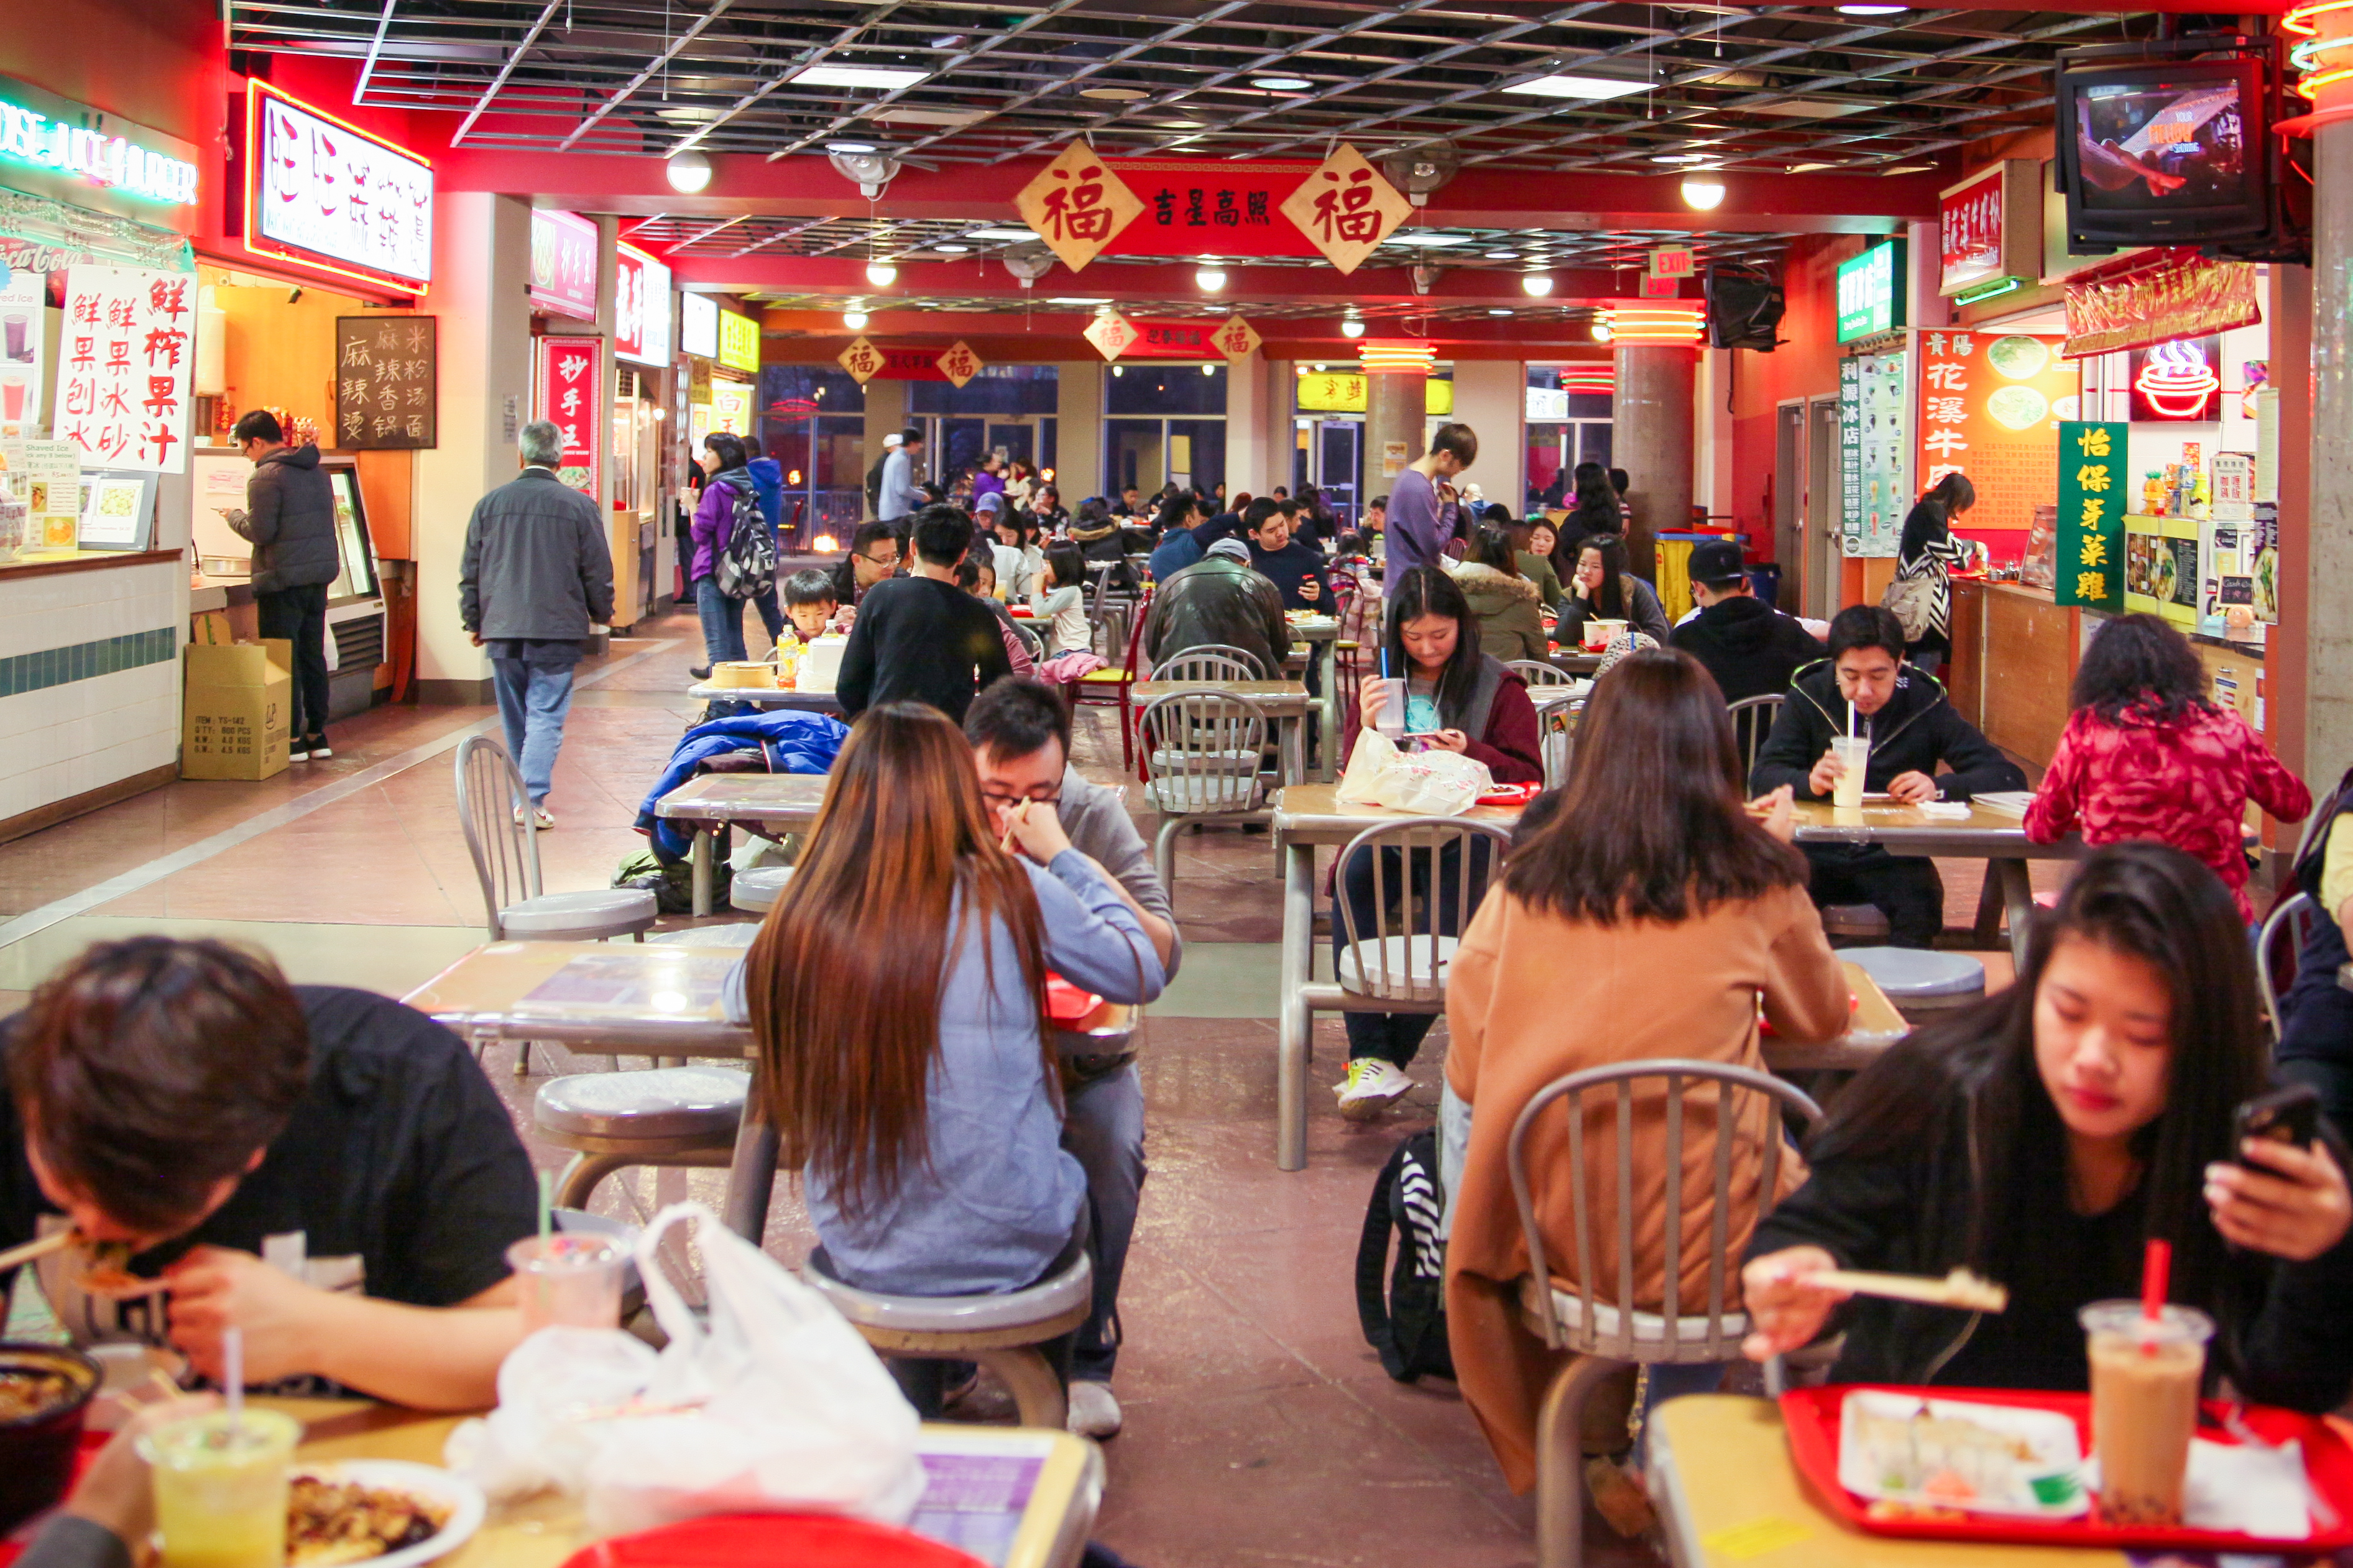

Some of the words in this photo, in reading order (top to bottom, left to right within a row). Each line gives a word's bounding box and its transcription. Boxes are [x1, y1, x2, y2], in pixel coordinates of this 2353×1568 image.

[2176, 111, 2193, 122] YOUR
[48, 121, 108, 179] JUICE
[1041, 165, 1113, 242] 福
[1153, 188, 1270, 227] 吉星高照
[1312, 167, 1382, 244] 福
[1658, 252, 1688, 273] EXIT
[17, 294, 34, 303] Ice
[1100, 319, 1125, 347] 福
[1223, 326, 1249, 353] 福
[1926, 332, 1974, 357] 貴陽
[63, 293, 101, 453] 鮮果刨冰
[97, 297, 137, 462] 鮮果冰砂
[141, 277, 188, 466] 鮮榨果汁
[849, 345, 875, 373] 福
[947, 349, 973, 377] 福
[558, 354, 589, 447] 抄手王
[1841, 362, 1860, 446] 利源冰店
[2074, 428, 2112, 601] 怡保芽菜雞
